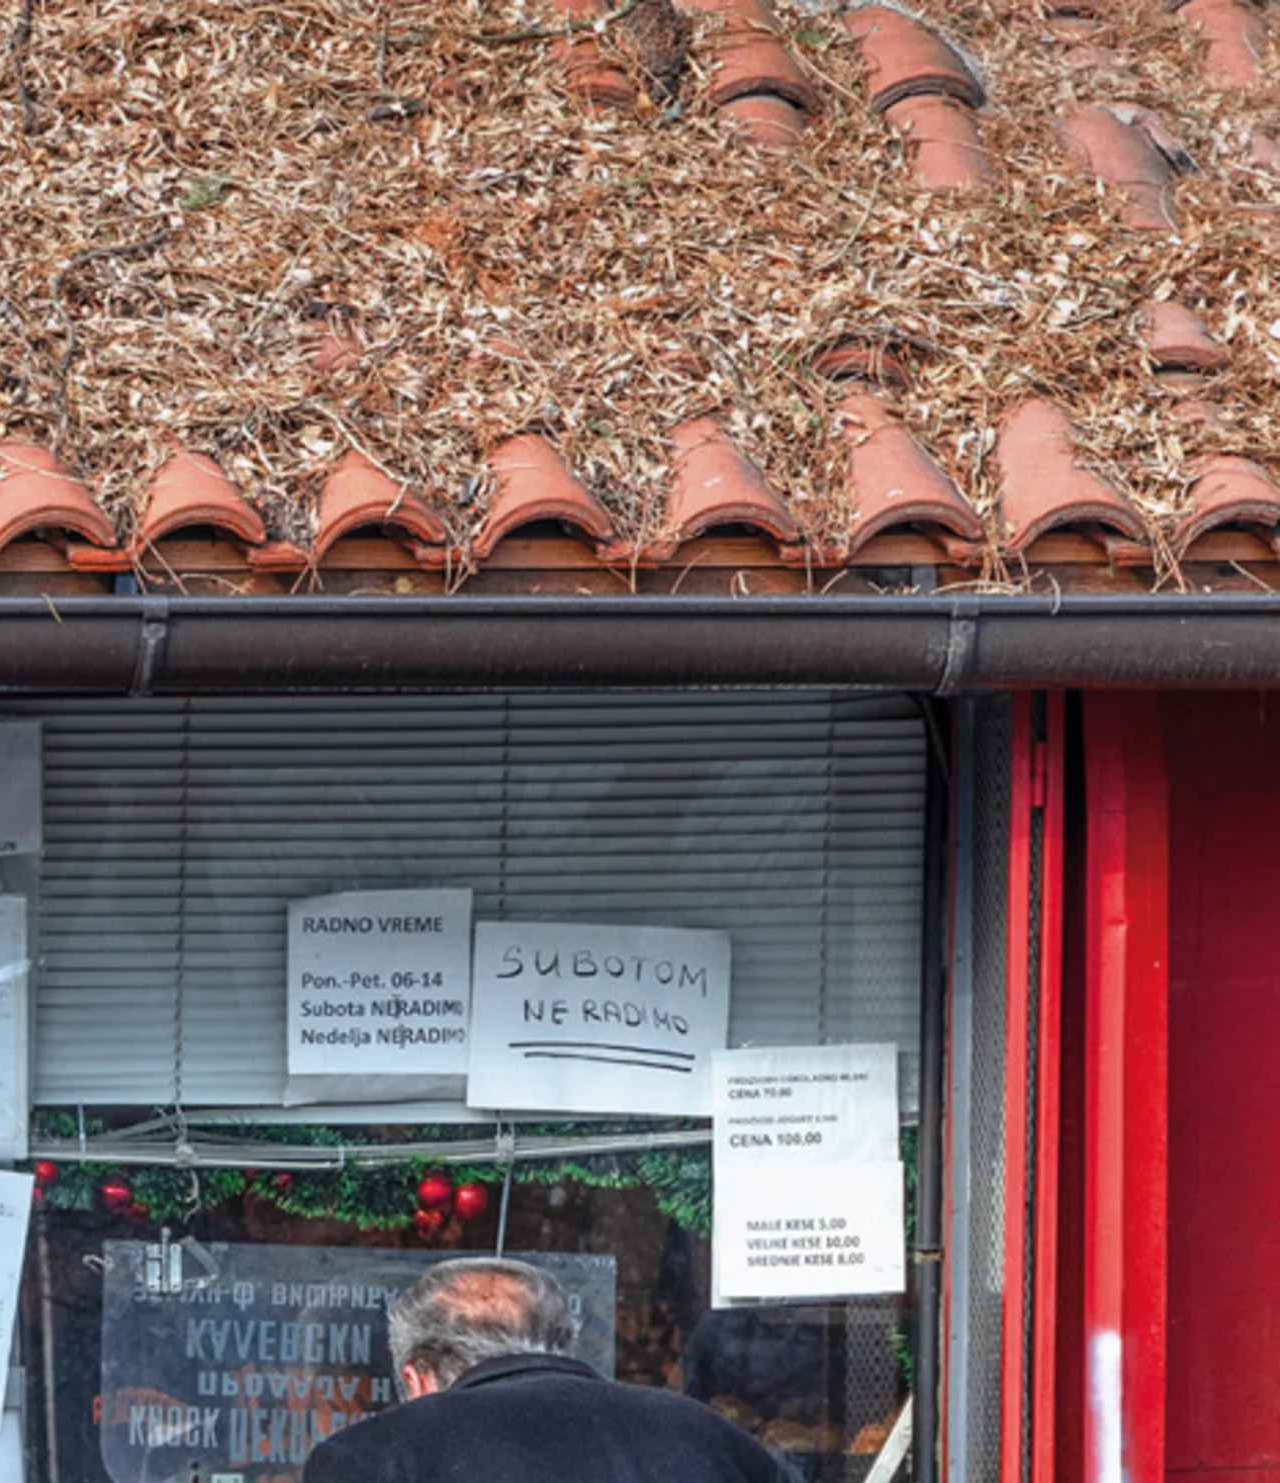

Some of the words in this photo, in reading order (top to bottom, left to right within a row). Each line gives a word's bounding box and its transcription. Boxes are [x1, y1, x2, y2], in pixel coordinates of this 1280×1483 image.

[302, 916, 373, 934] RADNO
[378, 916, 444, 933] VREME
[496, 944, 709, 998] SUBOTOM
[301, 971, 386, 990] Pon.-Pet.
[391, 971, 444, 988] 06-14
[300, 999, 366, 1018] Subota
[523, 998, 570, 1025] NE
[582, 997, 691, 1035] RADIMO
[300, 1027, 372, 1047] Nedelja
[728, 1087, 761, 1101] CENA
[729, 1133, 773, 1149] CENA
[746, 1218, 782, 1232] MALE
[784, 1217, 817, 1231] KESE
[746, 1237, 788, 1251] VELIKE
[791, 1236, 823, 1250] KESE
[804, 1254, 834, 1267] KESE
